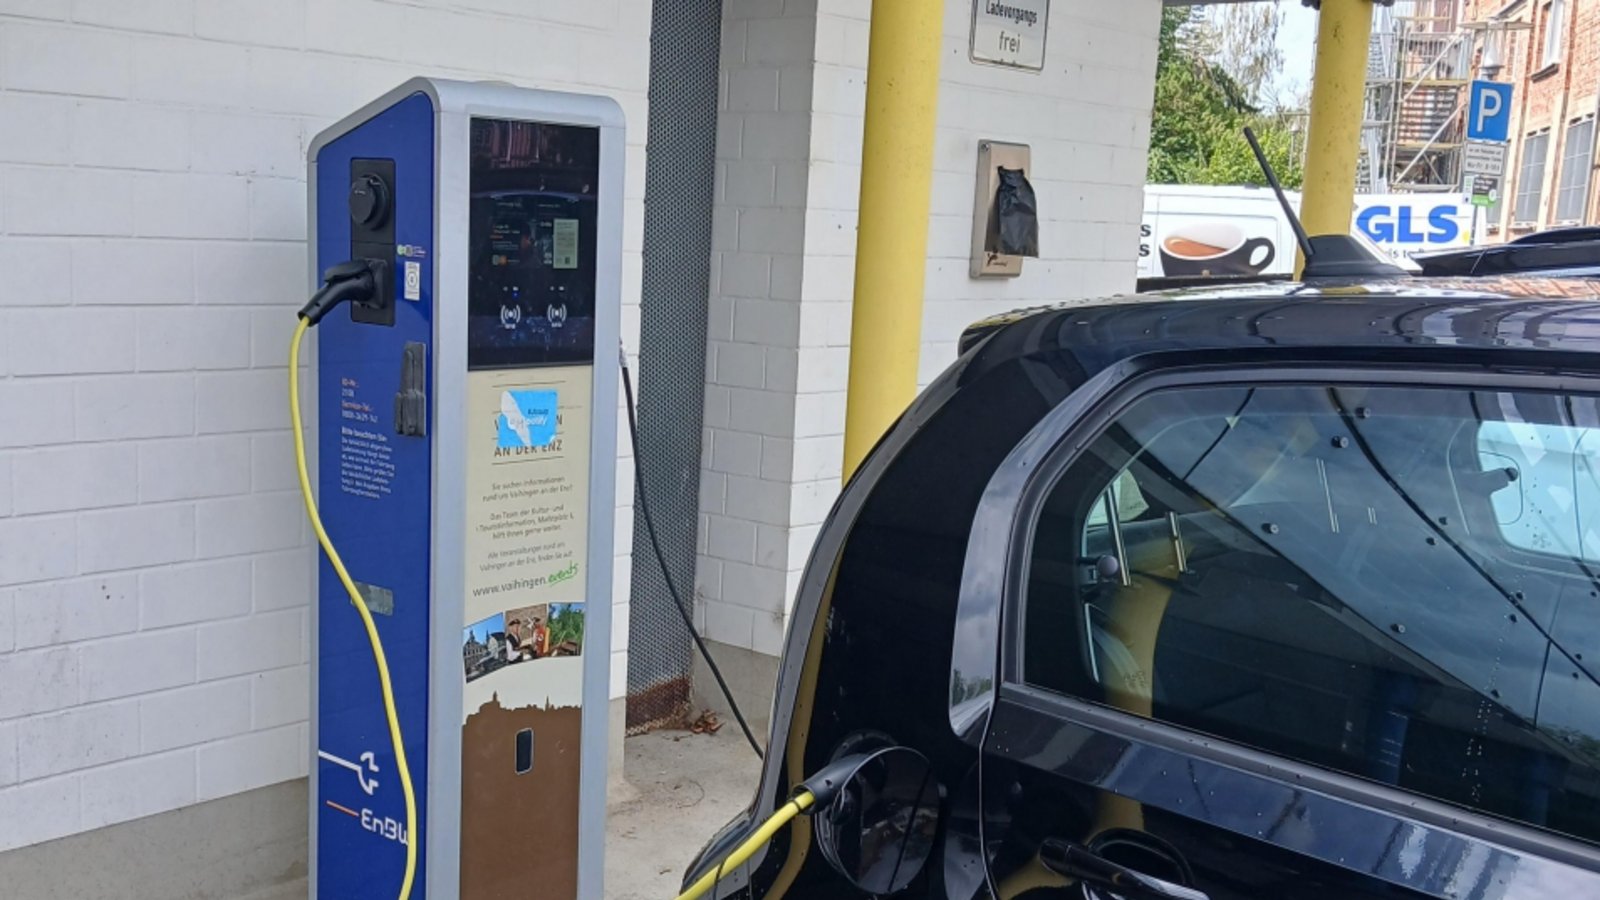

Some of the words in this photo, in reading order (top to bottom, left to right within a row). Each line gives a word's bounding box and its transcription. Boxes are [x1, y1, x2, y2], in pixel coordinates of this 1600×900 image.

[986, 0, 1037, 27] Ladevorgangs
[999, 30, 1021, 53] frei
[1476, 88, 1502, 132] P
[1356, 205, 1459, 243] GLS
[510, 490, 539, 498] Vaihingen
